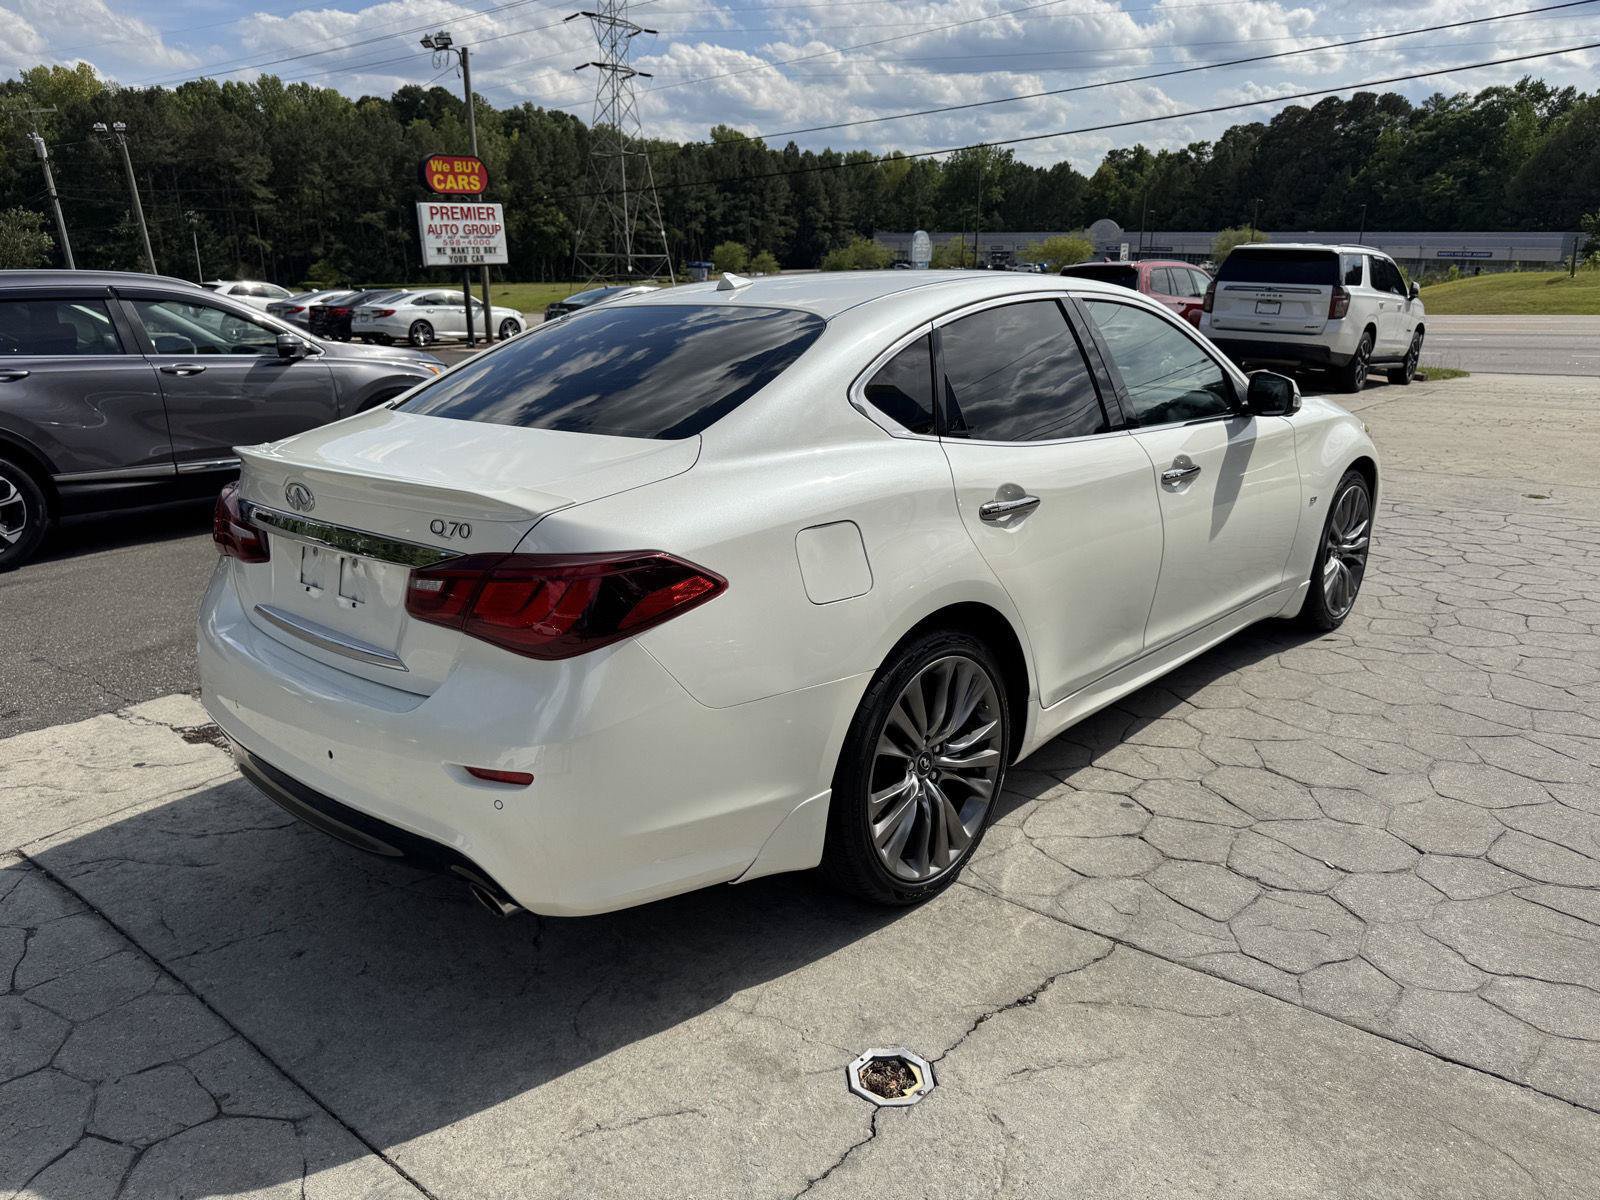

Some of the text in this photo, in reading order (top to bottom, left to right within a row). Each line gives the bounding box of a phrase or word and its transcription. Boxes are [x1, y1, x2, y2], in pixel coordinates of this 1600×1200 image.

[430, 160, 481, 173] We BUY
[432, 174, 481, 190] CARS
[429, 206, 496, 220] PREMIER
[427, 223, 502, 235] AUTO GROUP
[436, 246, 497, 255] WE WANT TO BUY
[449, 254, 485, 263] YOUR CAR
[429, 519, 472, 540] Q70
